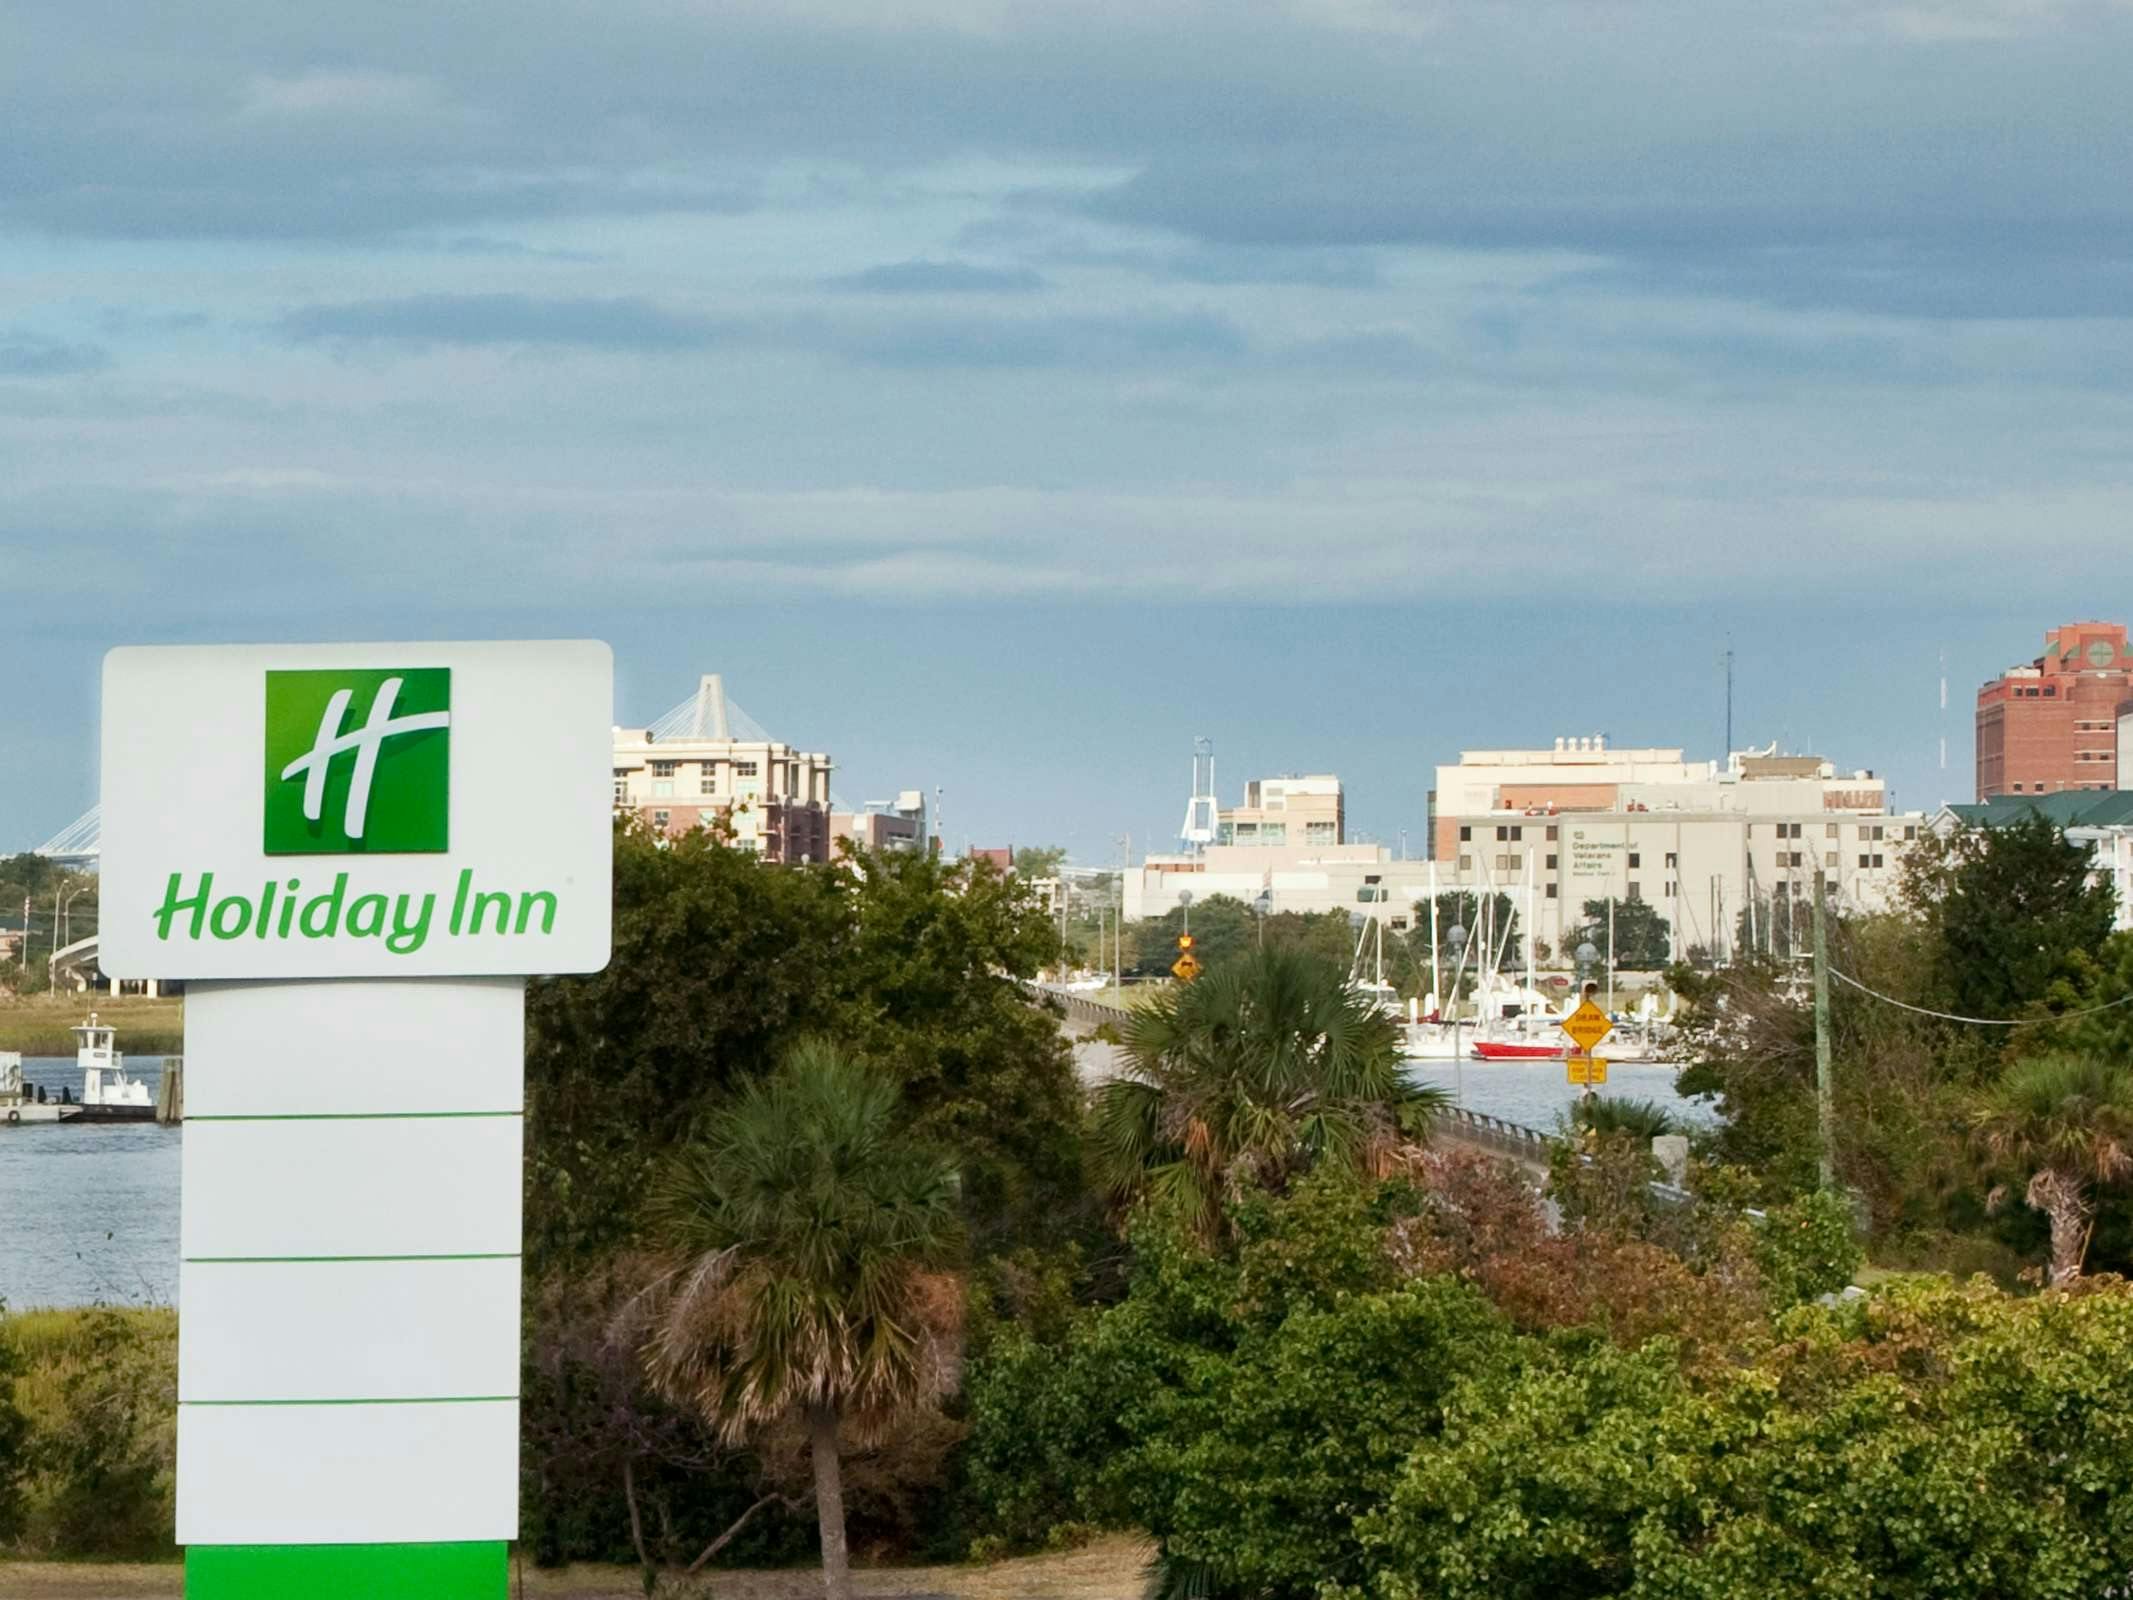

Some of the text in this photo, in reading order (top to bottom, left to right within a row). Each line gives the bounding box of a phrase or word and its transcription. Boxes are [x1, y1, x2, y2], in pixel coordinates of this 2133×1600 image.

[281, 677, 450, 839] H
[1572, 842, 1625, 850] Department
[153, 868, 558, 955] Holiday Inn
[1572, 1026, 1602, 1034] BRIDGE
